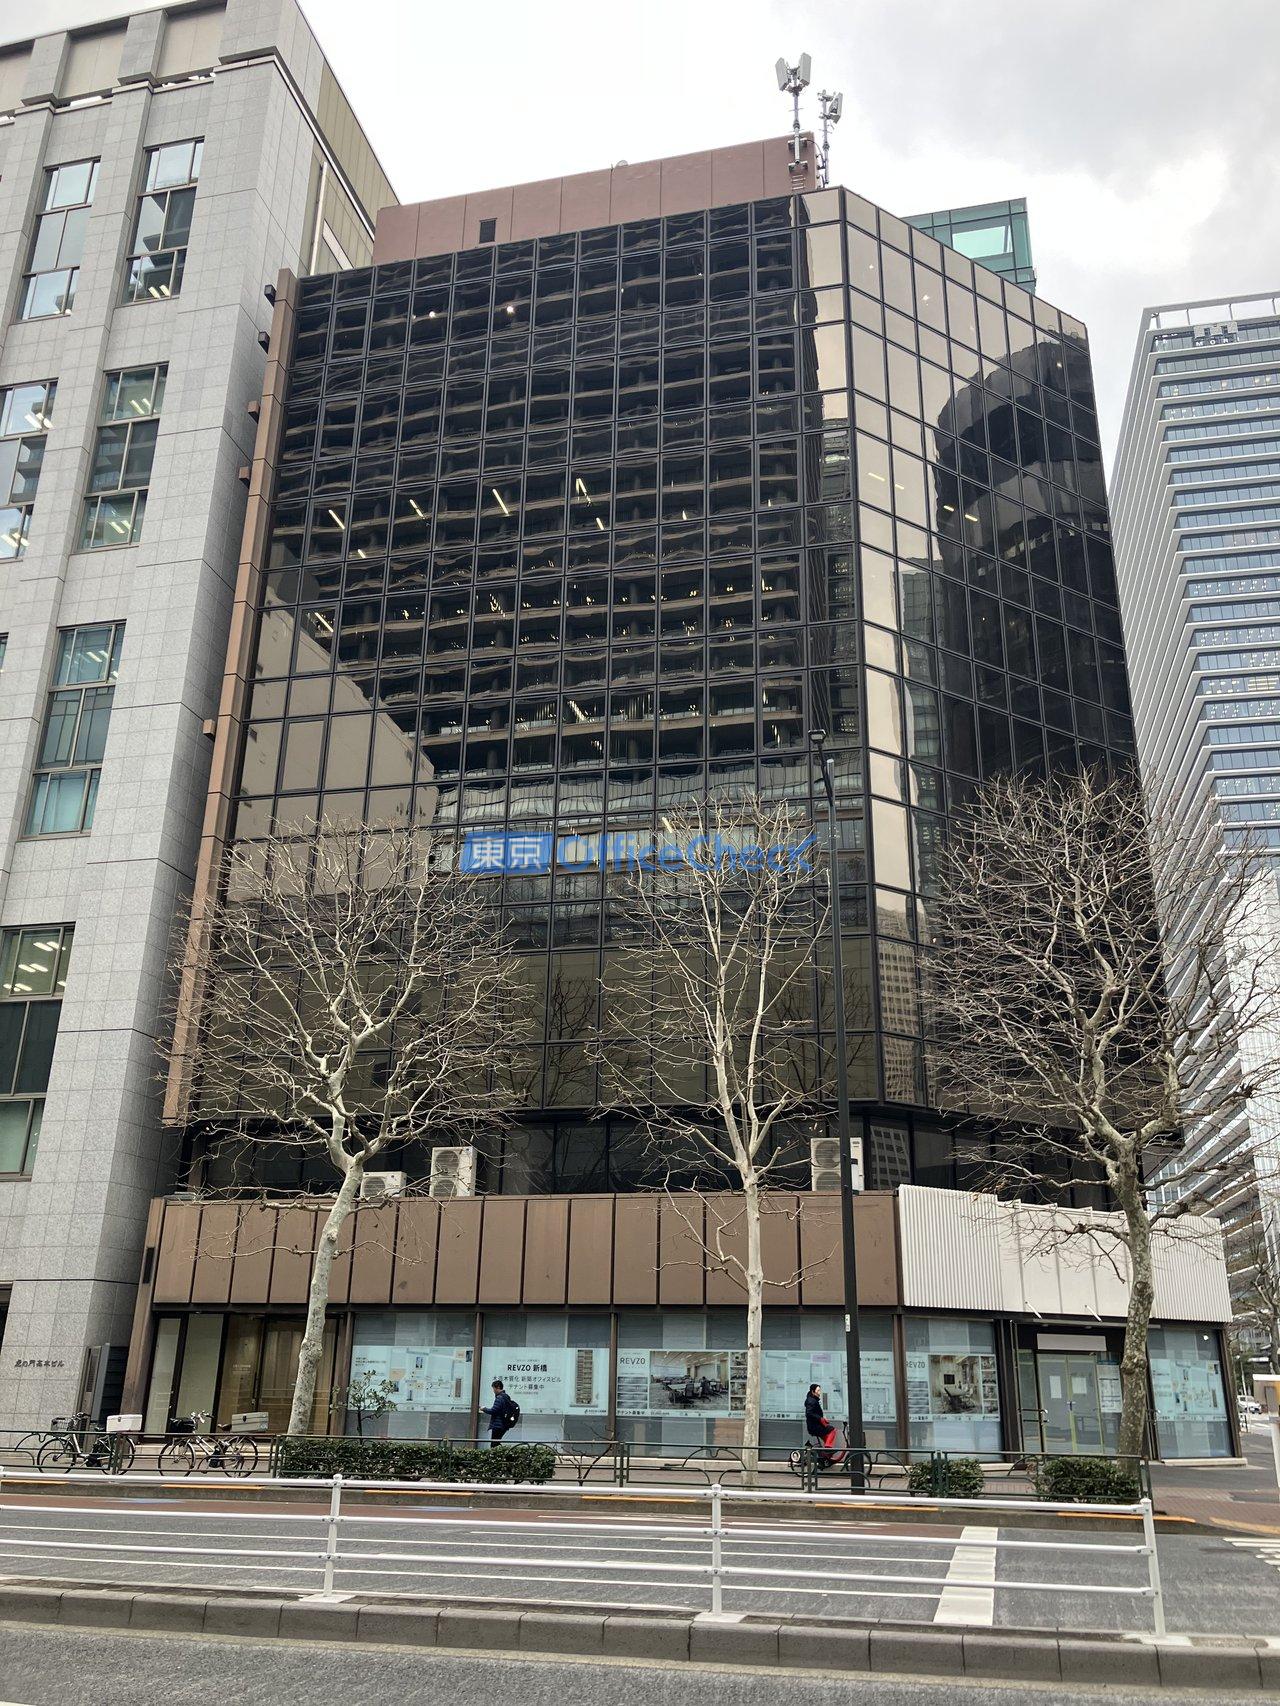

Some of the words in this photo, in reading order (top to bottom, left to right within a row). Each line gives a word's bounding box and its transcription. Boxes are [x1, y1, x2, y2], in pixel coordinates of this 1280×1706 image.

[1195, 336, 1240, 347] MORI
[619, 1357, 646, 1365] REVZO
[507, 1364, 531, 1372] REVZO
[532, 1364, 548, 1373] 新橋
